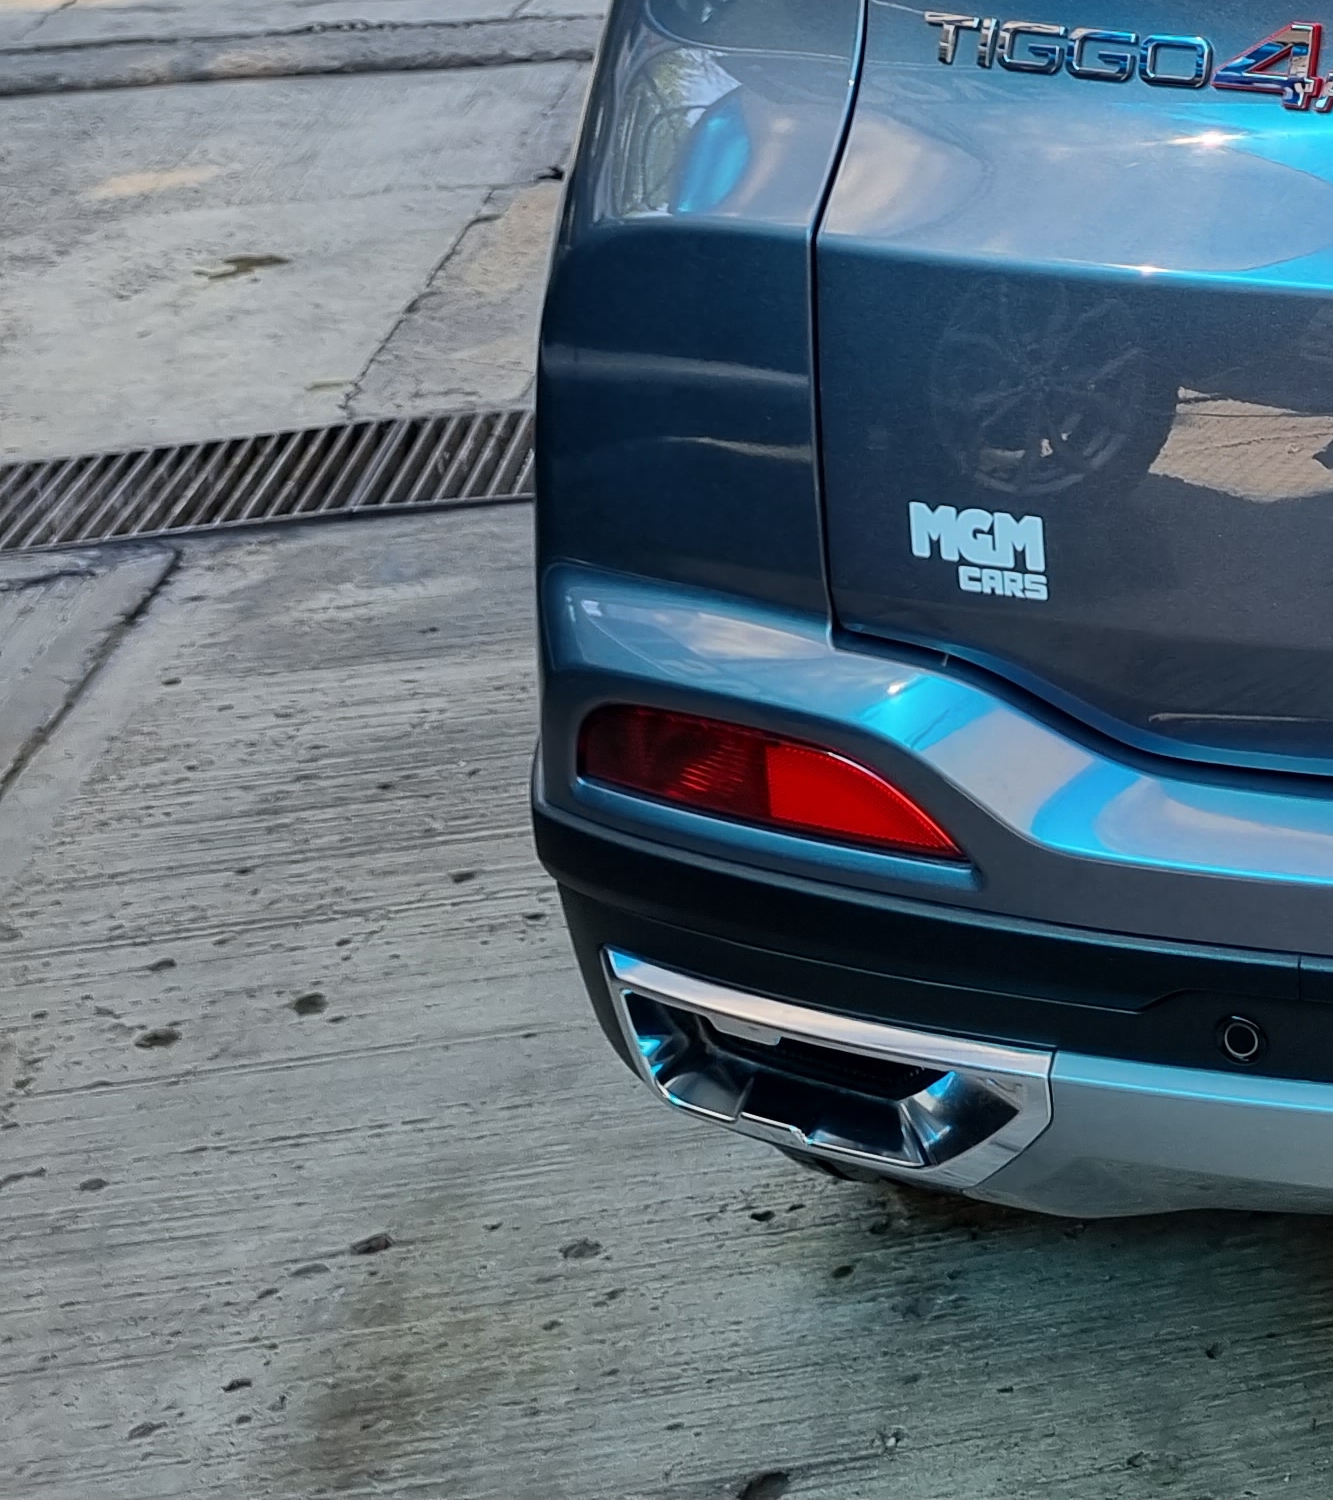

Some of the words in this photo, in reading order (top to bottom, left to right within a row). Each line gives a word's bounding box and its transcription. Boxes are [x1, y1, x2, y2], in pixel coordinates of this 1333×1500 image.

[924, 10, 1214, 88] TIGGO
[909, 501, 1046, 572] MGM
[958, 565, 1048, 601] CARS
